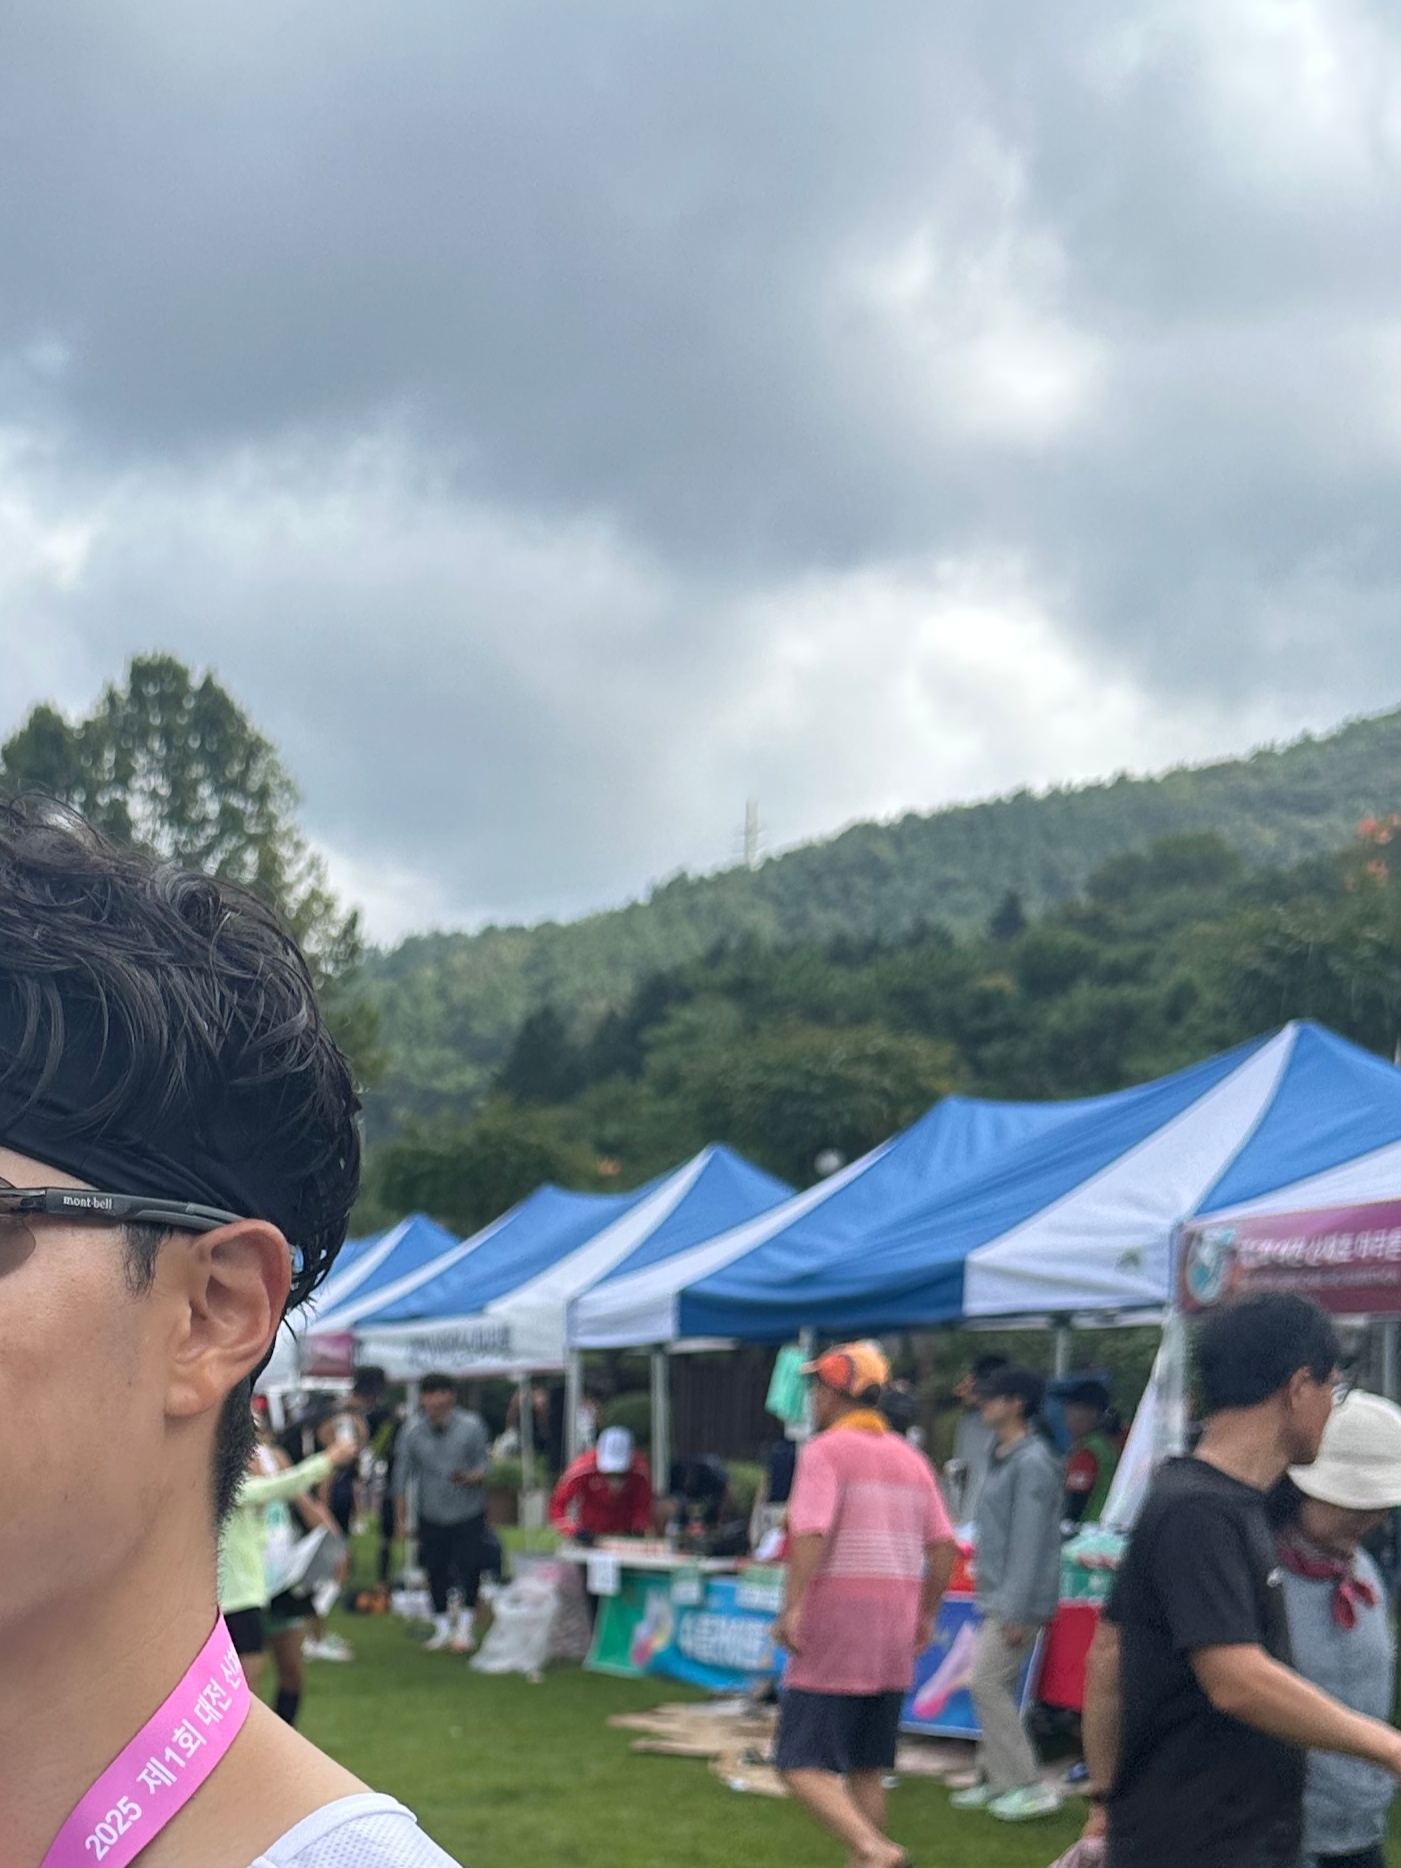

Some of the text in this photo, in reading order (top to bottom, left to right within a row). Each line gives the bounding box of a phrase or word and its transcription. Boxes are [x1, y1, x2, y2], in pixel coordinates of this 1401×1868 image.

[85, 1796, 142, 1861] 2025
[137, 1719, 207, 1795] 제1회
[193, 1677, 233, 1724] 대전
